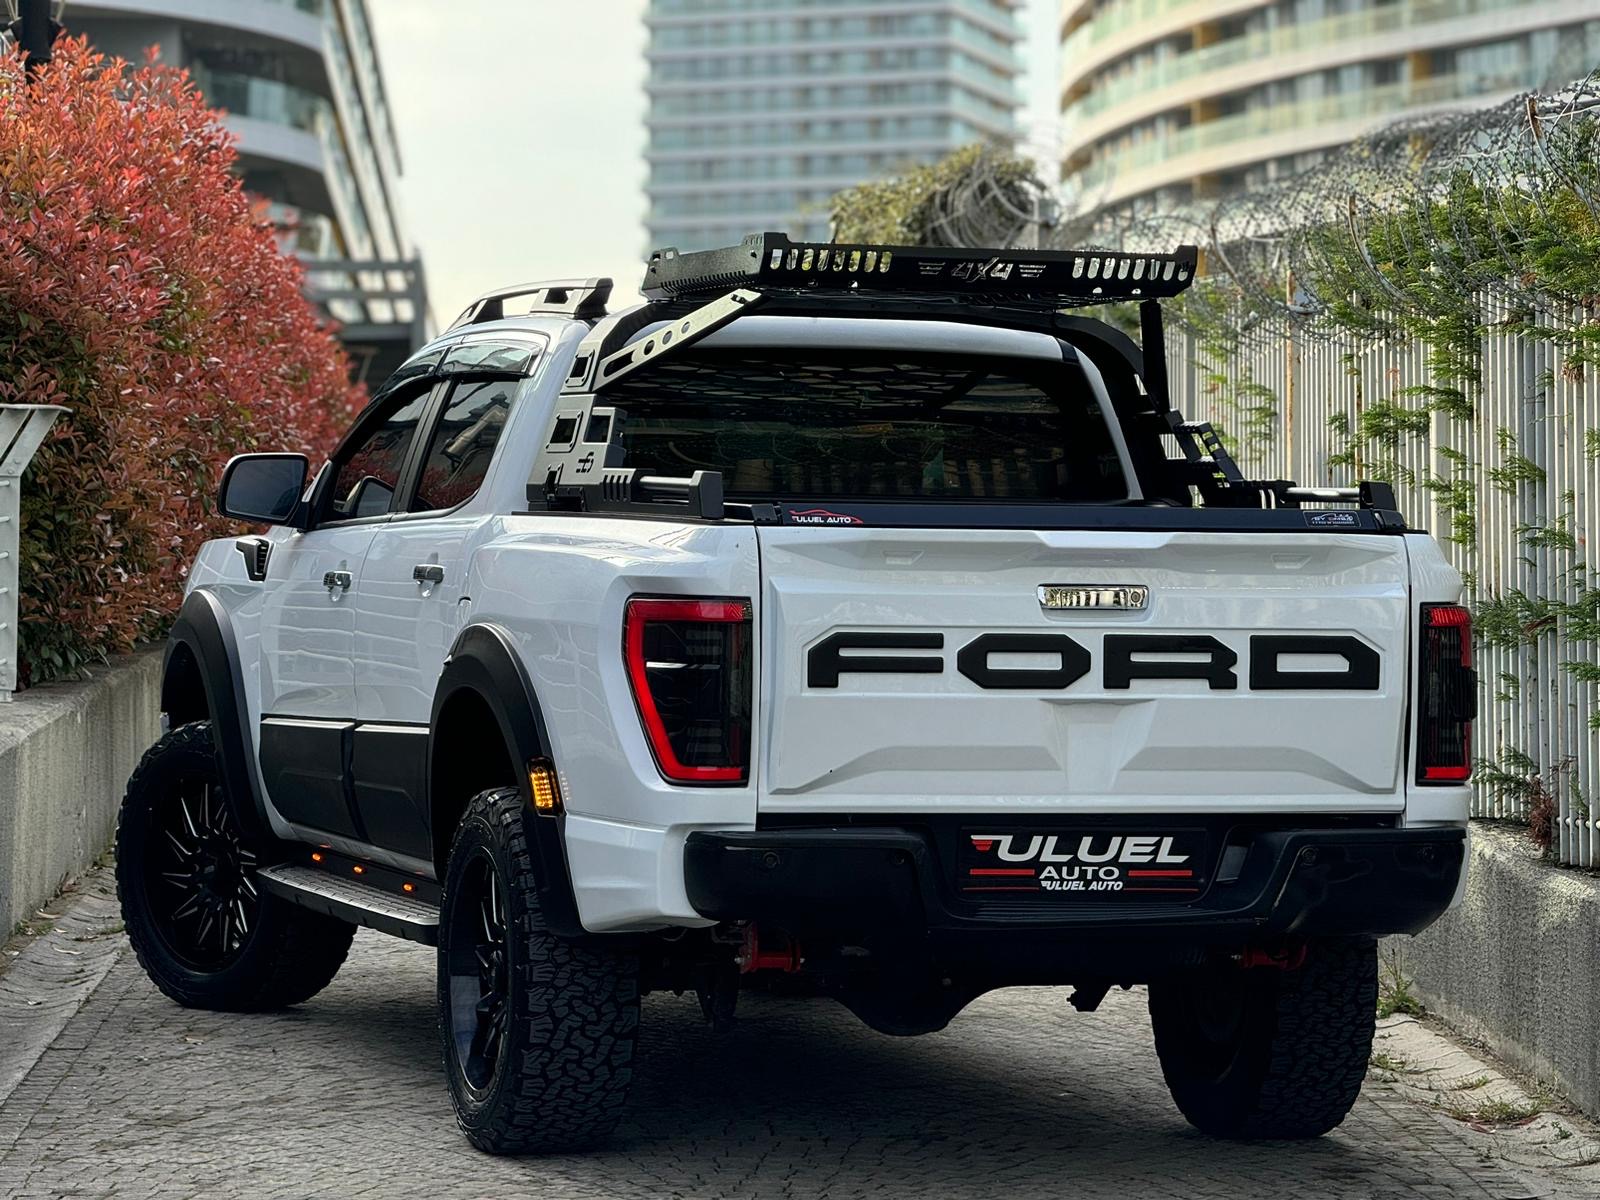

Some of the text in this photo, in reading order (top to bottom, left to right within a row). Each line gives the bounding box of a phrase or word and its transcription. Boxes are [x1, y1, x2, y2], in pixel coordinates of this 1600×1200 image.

[826, 516, 852, 524] AUTO
[808, 632, 1381, 691] FORD
[971, 834, 1190, 863] ULUEL
[1039, 866, 1120, 880] AUTO
[1041, 880, 1123, 891] ULUEL AUTO
